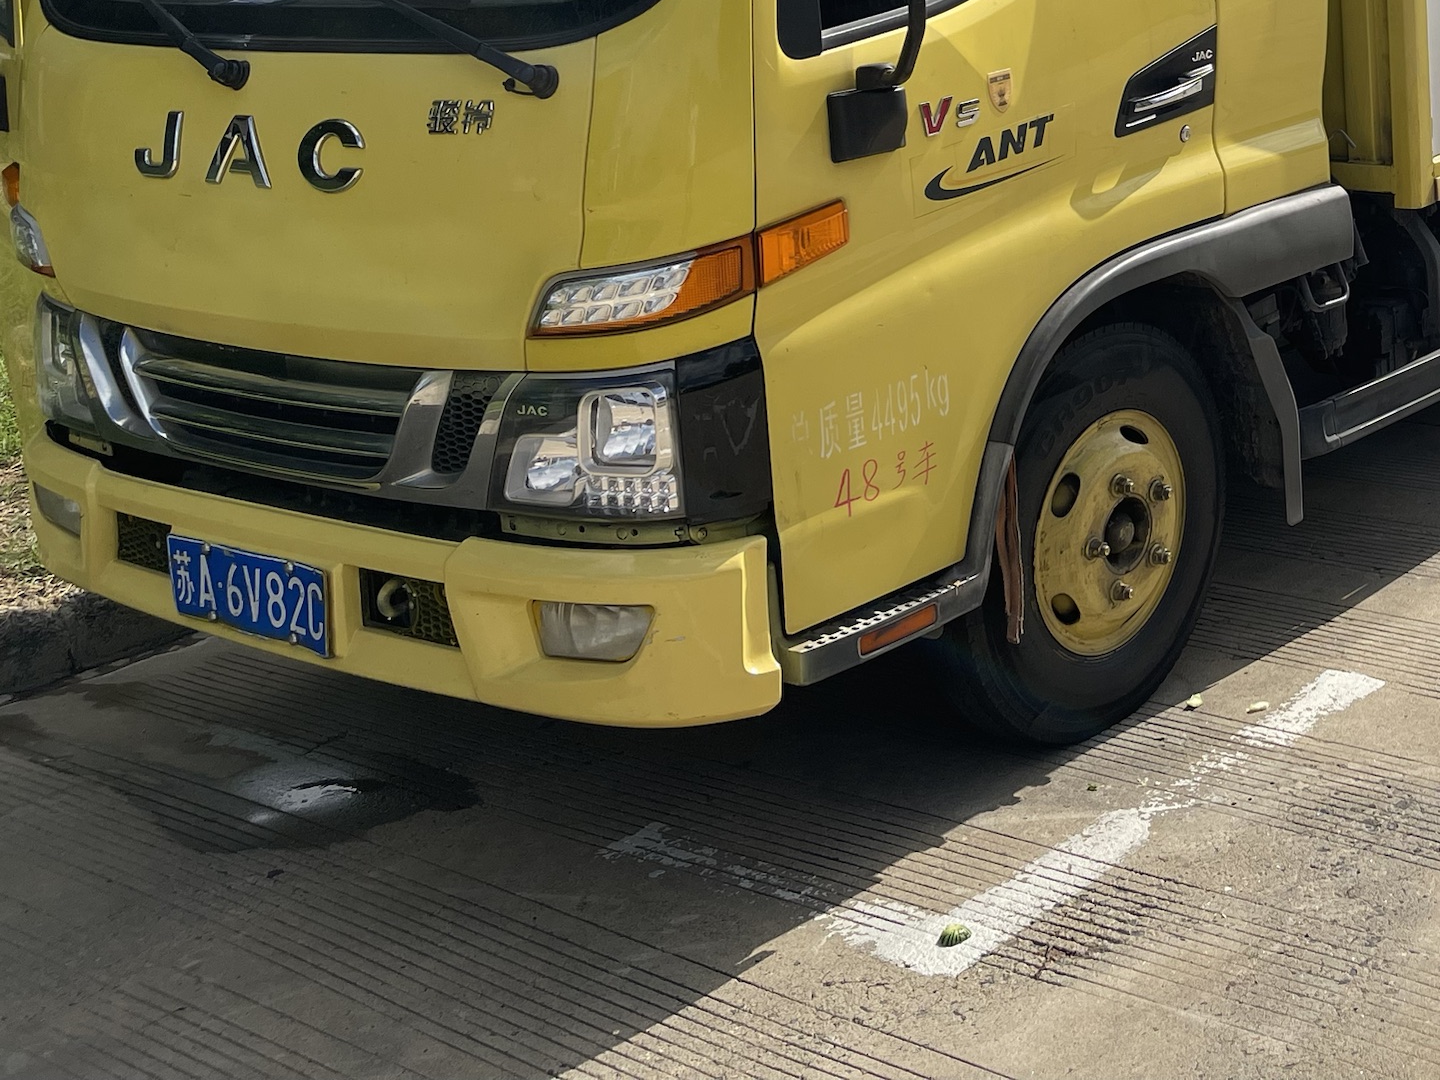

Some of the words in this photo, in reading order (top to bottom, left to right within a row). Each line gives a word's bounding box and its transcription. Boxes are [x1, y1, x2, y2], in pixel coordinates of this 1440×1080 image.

[1191, 48, 1214, 63] JAC
[134, 110, 366, 194] JAC
[966, 113, 1055, 174] ANT
[516, 404, 548, 417] JAC
[834, 440, 938, 518] 48号车
